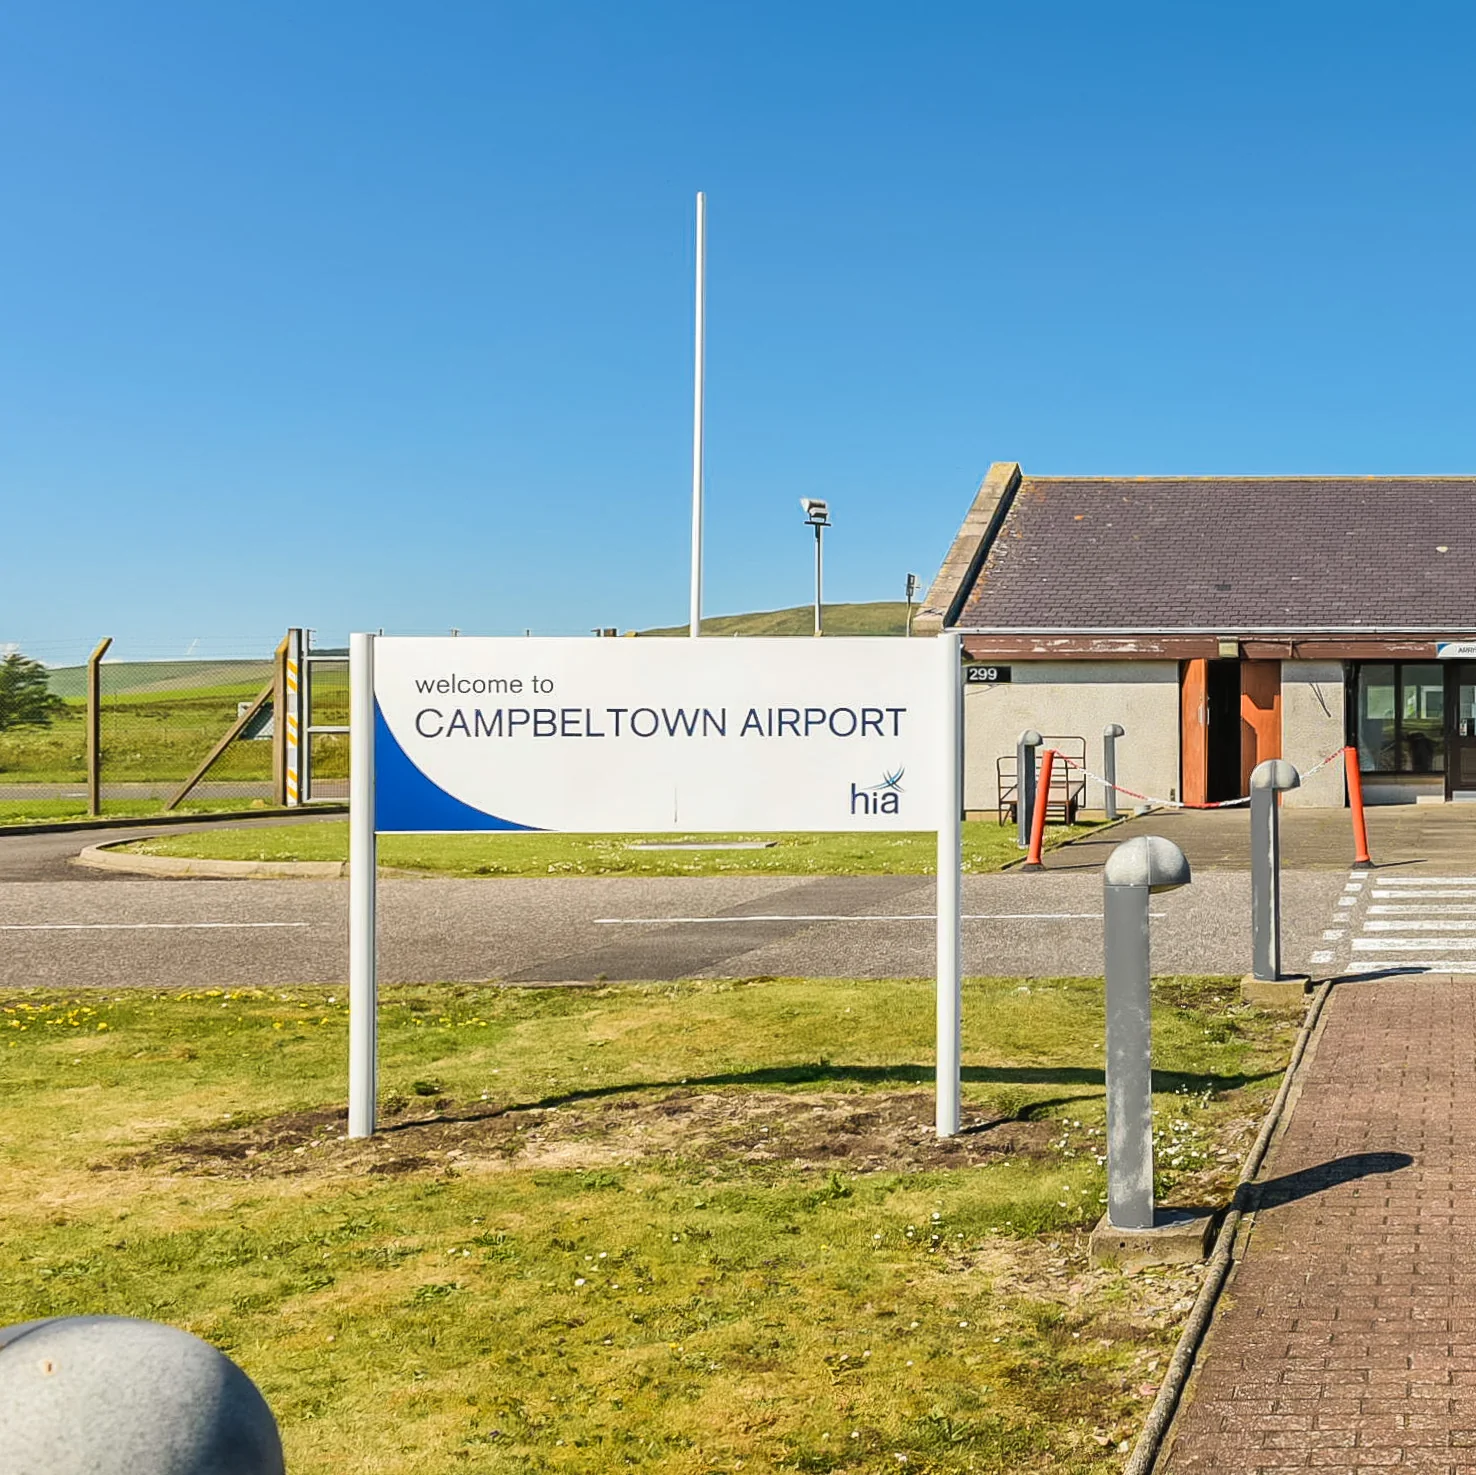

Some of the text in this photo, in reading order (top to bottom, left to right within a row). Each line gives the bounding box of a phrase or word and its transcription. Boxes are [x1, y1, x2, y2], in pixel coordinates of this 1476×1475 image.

[415, 674, 554, 694] welcome to
[969, 668, 998, 680] 299
[415, 707, 907, 738] CAMPBELTOWN AIRPORT
[851, 782, 899, 815] hia
